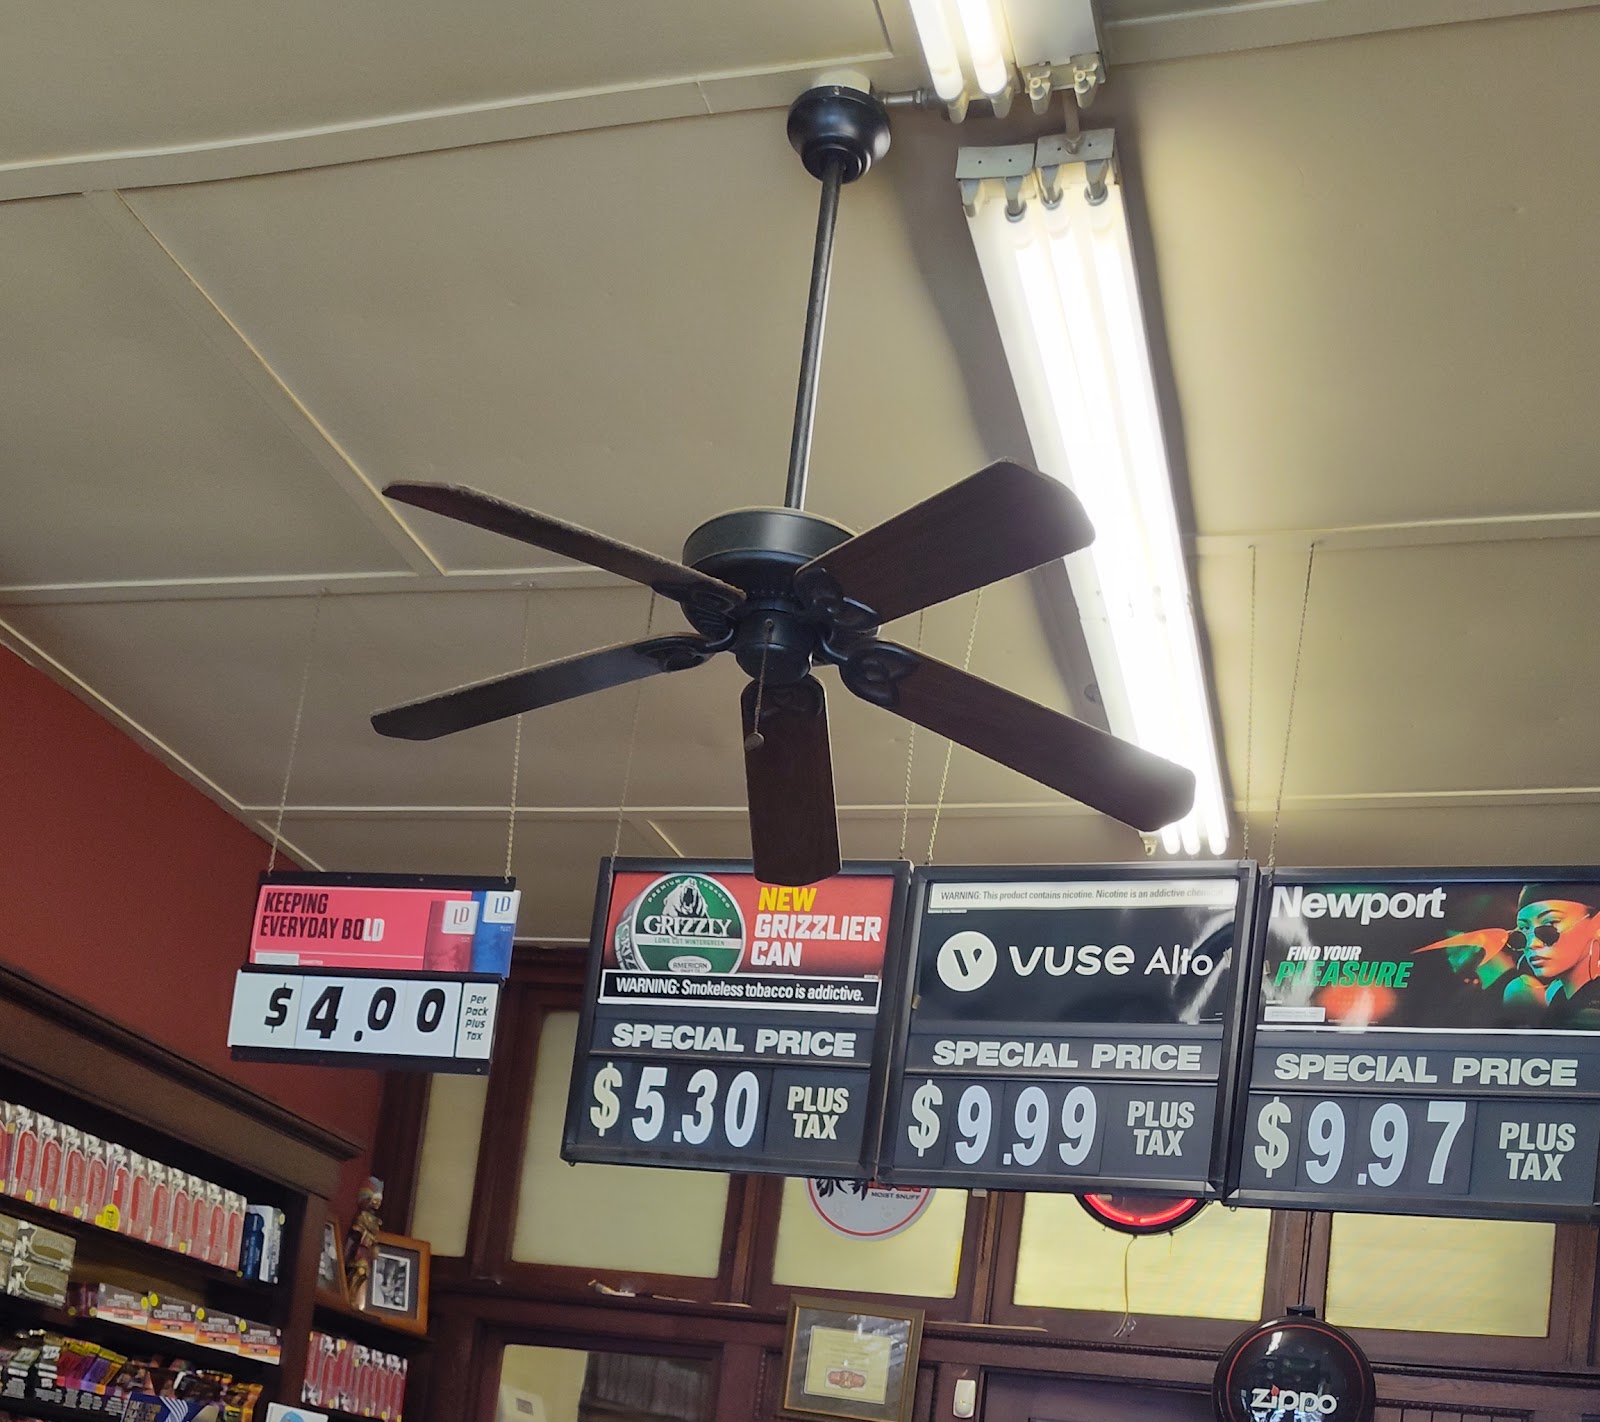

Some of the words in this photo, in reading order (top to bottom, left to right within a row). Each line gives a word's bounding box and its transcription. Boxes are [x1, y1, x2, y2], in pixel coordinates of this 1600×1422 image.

[264, 892, 329, 914] KEEPING
[758, 886, 817, 912] NEW
[940, 890, 980, 900] WARNING:
[982, 889, 999, 900] This
[999, 890, 1028, 902] product
[1028, 889, 1061, 900] contains
[1061, 888, 1094, 900] nicotine.
[1095, 888, 1128, 899] Nicotine
[1129, 888, 1137, 899] is
[1138, 891, 1148, 899] an
[1149, 887, 1186, 899] addictive
[1271, 886, 1447, 926] Newport
[260, 915, 340, 940] EVERYDAY
[341, 918, 386, 943] BOLD
[643, 915, 733, 939] GRIZZLY
[754, 913, 881, 941] GRIZZLIER
[750, 941, 803, 967] CAN
[1143, 943, 1215, 977] Alto
[1286, 946, 1322, 961] FIND
[1323, 945, 1363, 961] YOUR
[1273, 961, 1415, 988] PLEASURE
[469, 994, 488, 1005] Per
[615, 976, 681, 995] WARNING:
[681, 979, 744, 997] Smokeless
[745, 983, 794, 999] tobacco
[795, 984, 806, 999] is
[806, 985, 865, 1002] addictive.
[465, 1006, 490, 1018] Pack
[465, 1018, 487, 1030] Plus
[465, 1031, 484, 1042] Tax
[611, 1022, 745, 1053] SPECIAL
[755, 1029, 857, 1058] PRICE
[932, 1039, 1079, 1069] SPECIAL
[1091, 1043, 1203, 1071] PRICE
[1274, 1053, 1438, 1084] SPECIAL
[1452, 1057, 1578, 1087] PRICE
[786, 1085, 849, 1113] PLUS
[792, 1113, 839, 1140] TAX
[1127, 1100, 1196, 1129] PLUS
[1133, 1128, 1185, 1157] TAX
[1499, 1122, 1577, 1152] PLUS
[1505, 1153, 1563, 1182] TAX
